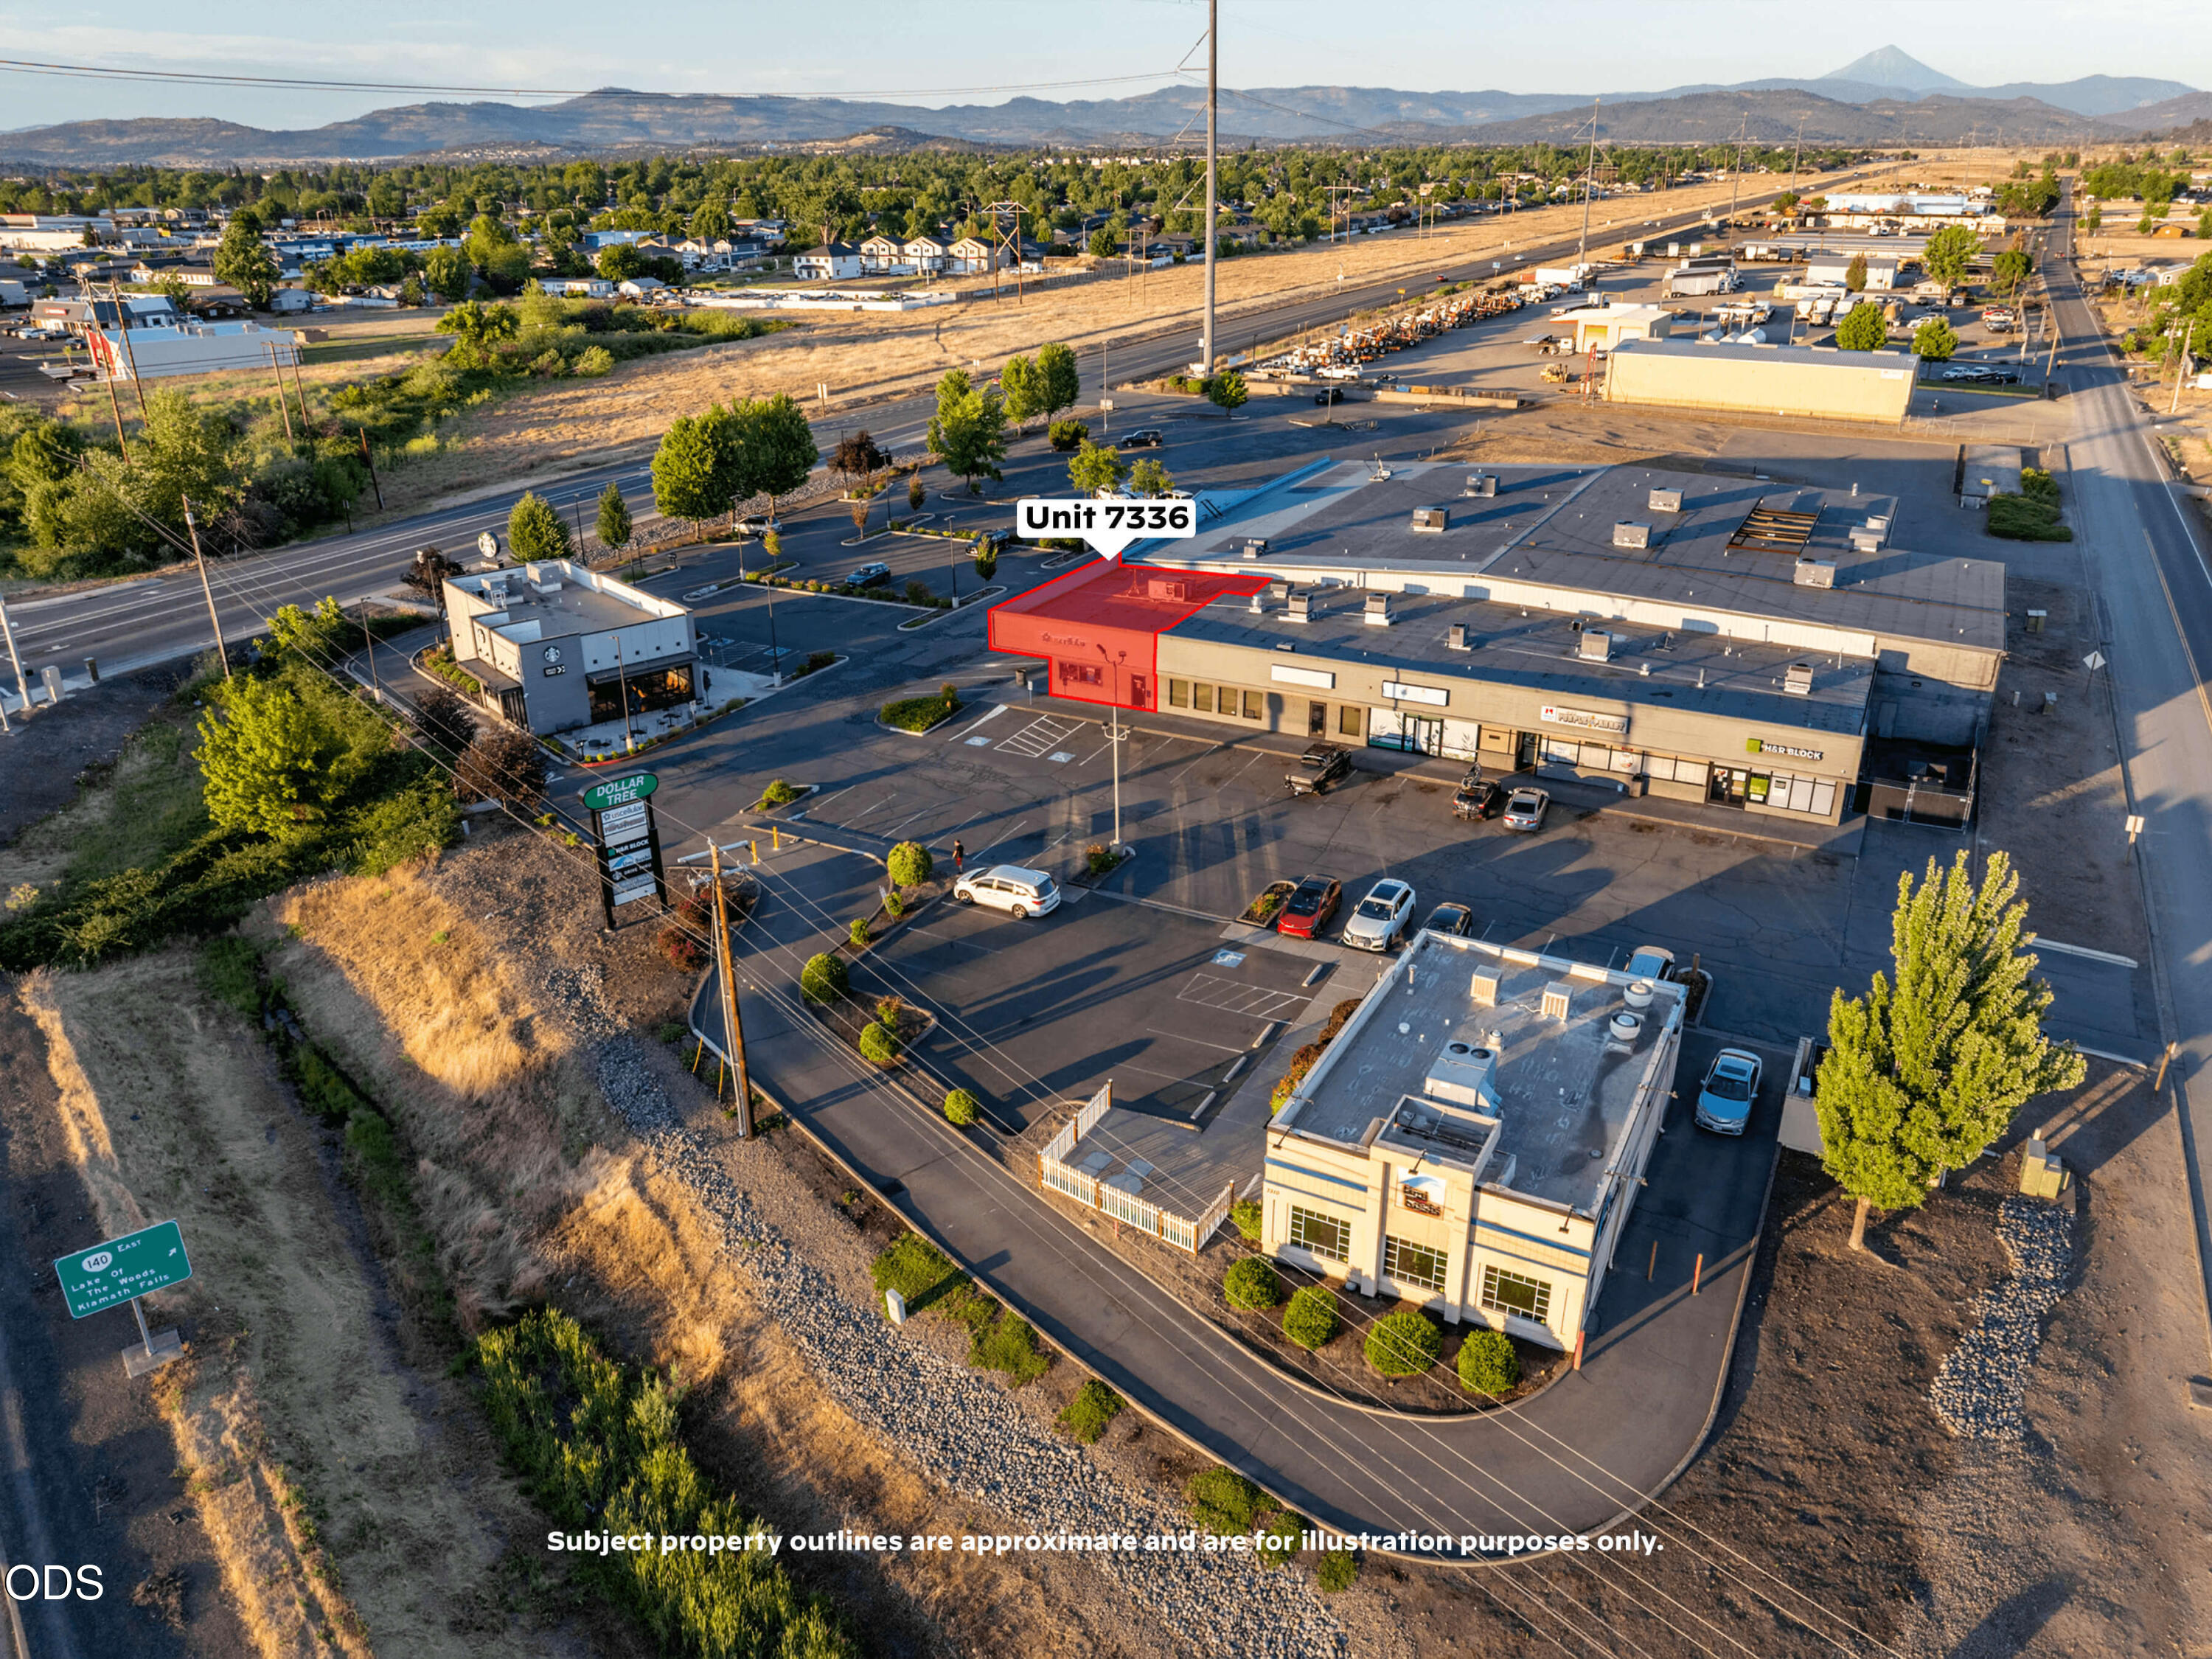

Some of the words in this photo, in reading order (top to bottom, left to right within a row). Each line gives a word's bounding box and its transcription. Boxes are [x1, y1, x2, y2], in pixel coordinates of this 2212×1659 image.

[1764, 744, 1786, 754] H&R
[1787, 748, 1822, 760] BLOCK
[597, 776, 644, 796] DOLLAR
[607, 789, 637, 806] TREE
[629, 838, 649, 849] BLOCK
[87, 1255, 108, 1268] 140
[71, 1278, 100, 1292] Lake
[111, 1268, 123, 1277] Of
[87, 1285, 108, 1296] The
[119, 1268, 156, 1285] Woods
[77, 1287, 131, 1310] Klamath
[139, 1274, 170, 1288] Falls
